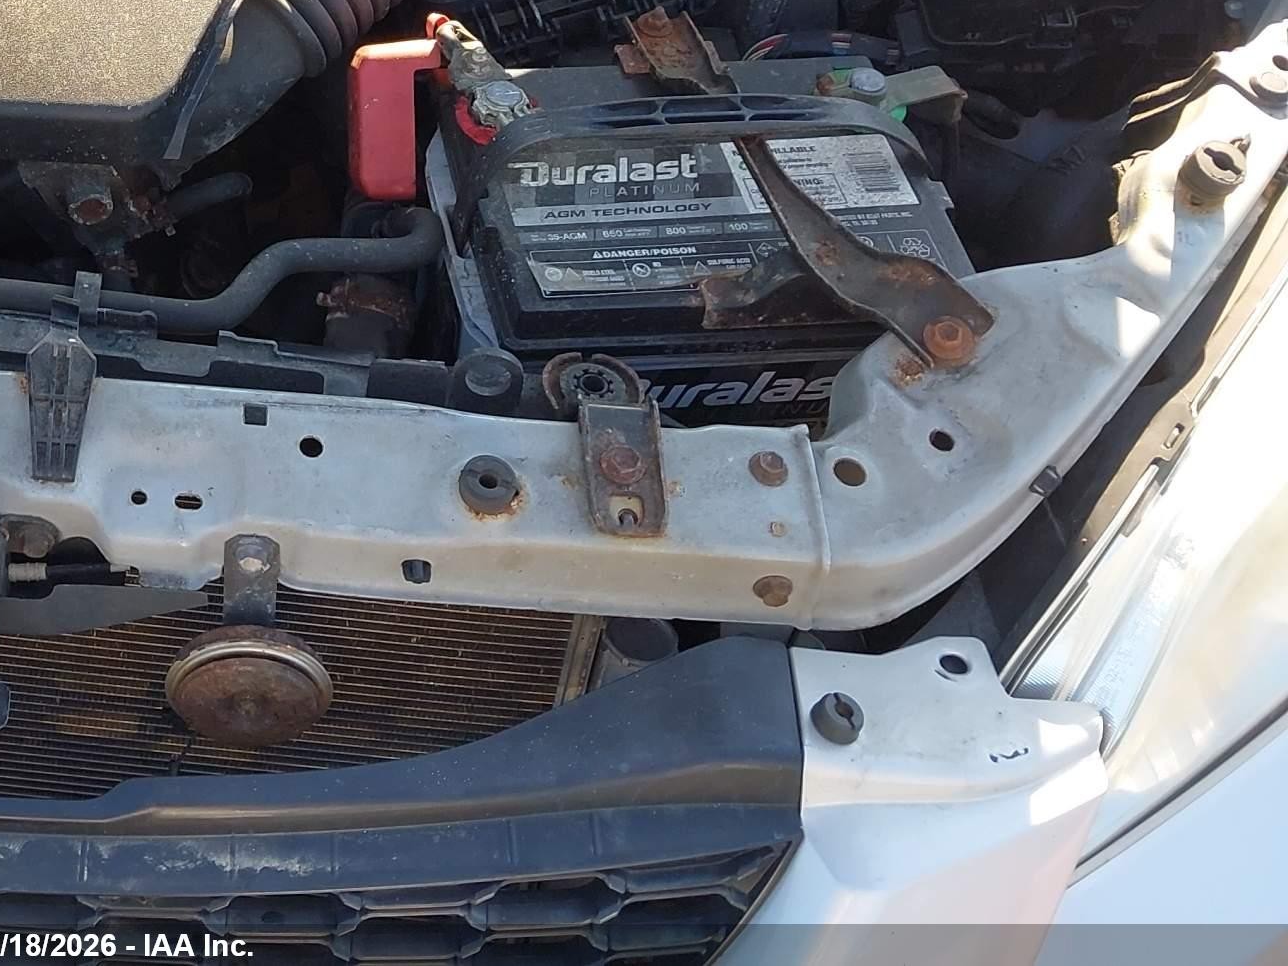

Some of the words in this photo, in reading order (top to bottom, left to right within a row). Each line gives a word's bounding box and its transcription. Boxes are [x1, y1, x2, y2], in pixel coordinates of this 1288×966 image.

[507, 153, 698, 186] Duralast
[590, 183, 699, 198] PLATINUM
[544, 208, 586, 220] AGM
[592, 202, 712, 217] TECHNOLOGY
[665, 226, 686, 235] 800
[728, 223, 748, 231] 100
[602, 245, 697, 259] DANGER/POISON
[640, 371, 836, 408] uralas
